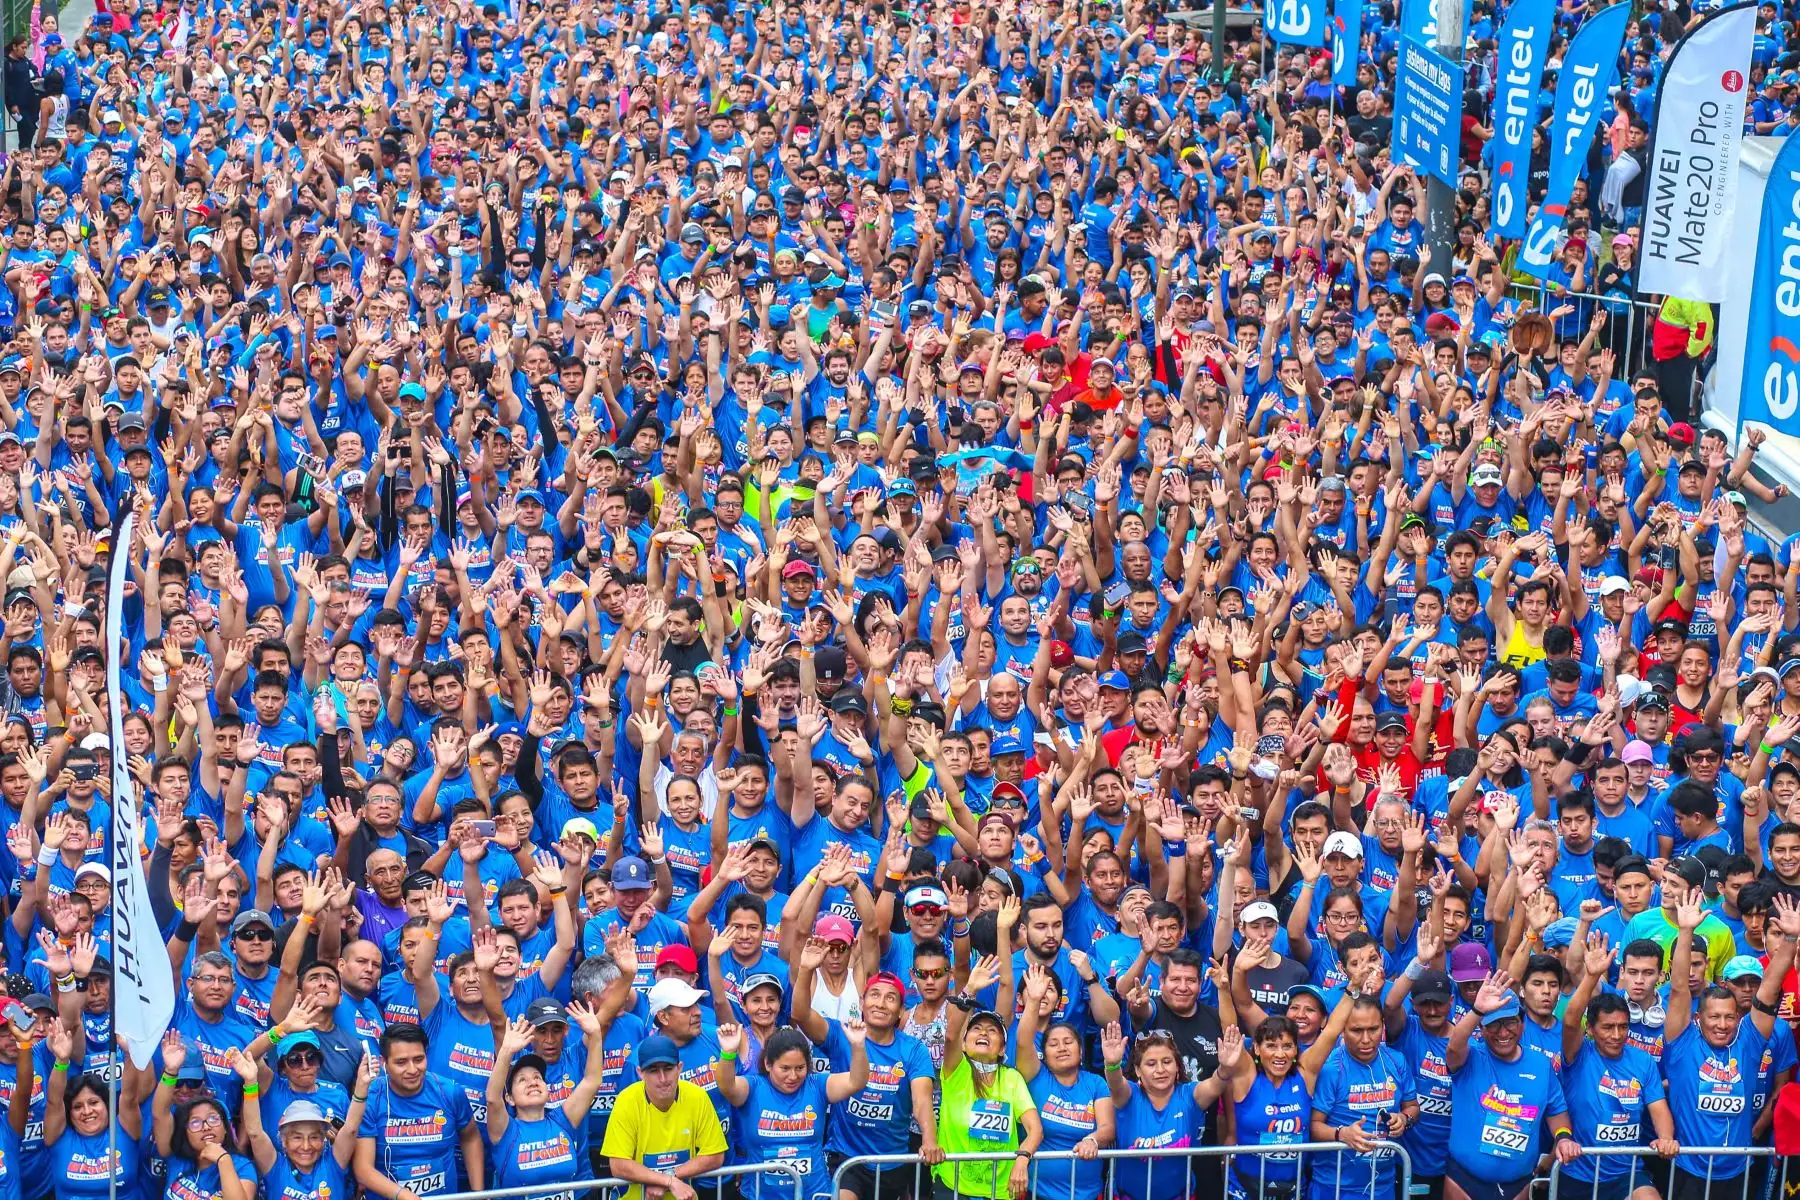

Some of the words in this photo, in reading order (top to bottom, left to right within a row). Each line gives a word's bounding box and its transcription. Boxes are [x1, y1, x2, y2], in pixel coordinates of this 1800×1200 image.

[1407, 45, 1428, 76] sistema
[1428, 62, 1438, 86] my
[1438, 63, 1451, 92] laps
[1504, 25, 1533, 146] entel
[1726, 72, 1737, 92] Leica
[1690, 101, 1719, 147] Pro
[1713, 133, 1732, 216] CO-ENGINEERED
[1724, 104, 1734, 132] WITH
[1649, 149, 1681, 260] HUAWEI
[1675, 155, 1713, 265] Mate20
[1350, 1084, 1373, 1092] ENTEL
[850, 1100, 891, 1120] 0584
[1047, 1094, 1074, 1111] ENTEL
[1280, 1103, 1301, 1114] entel
[1700, 1096, 1742, 1113] 0093
[387, 1118, 417, 1127] ENTEL
[761, 1109, 790, 1121] ENTEL
[972, 1113, 1010, 1132] 7220
[398, 1123, 443, 1137] POWER
[1484, 1127, 1528, 1149] 5627
[1598, 1125, 1638, 1141] 6534
[518, 1141, 546, 1152] ENTEL
[404, 1173, 442, 1197] 6704
